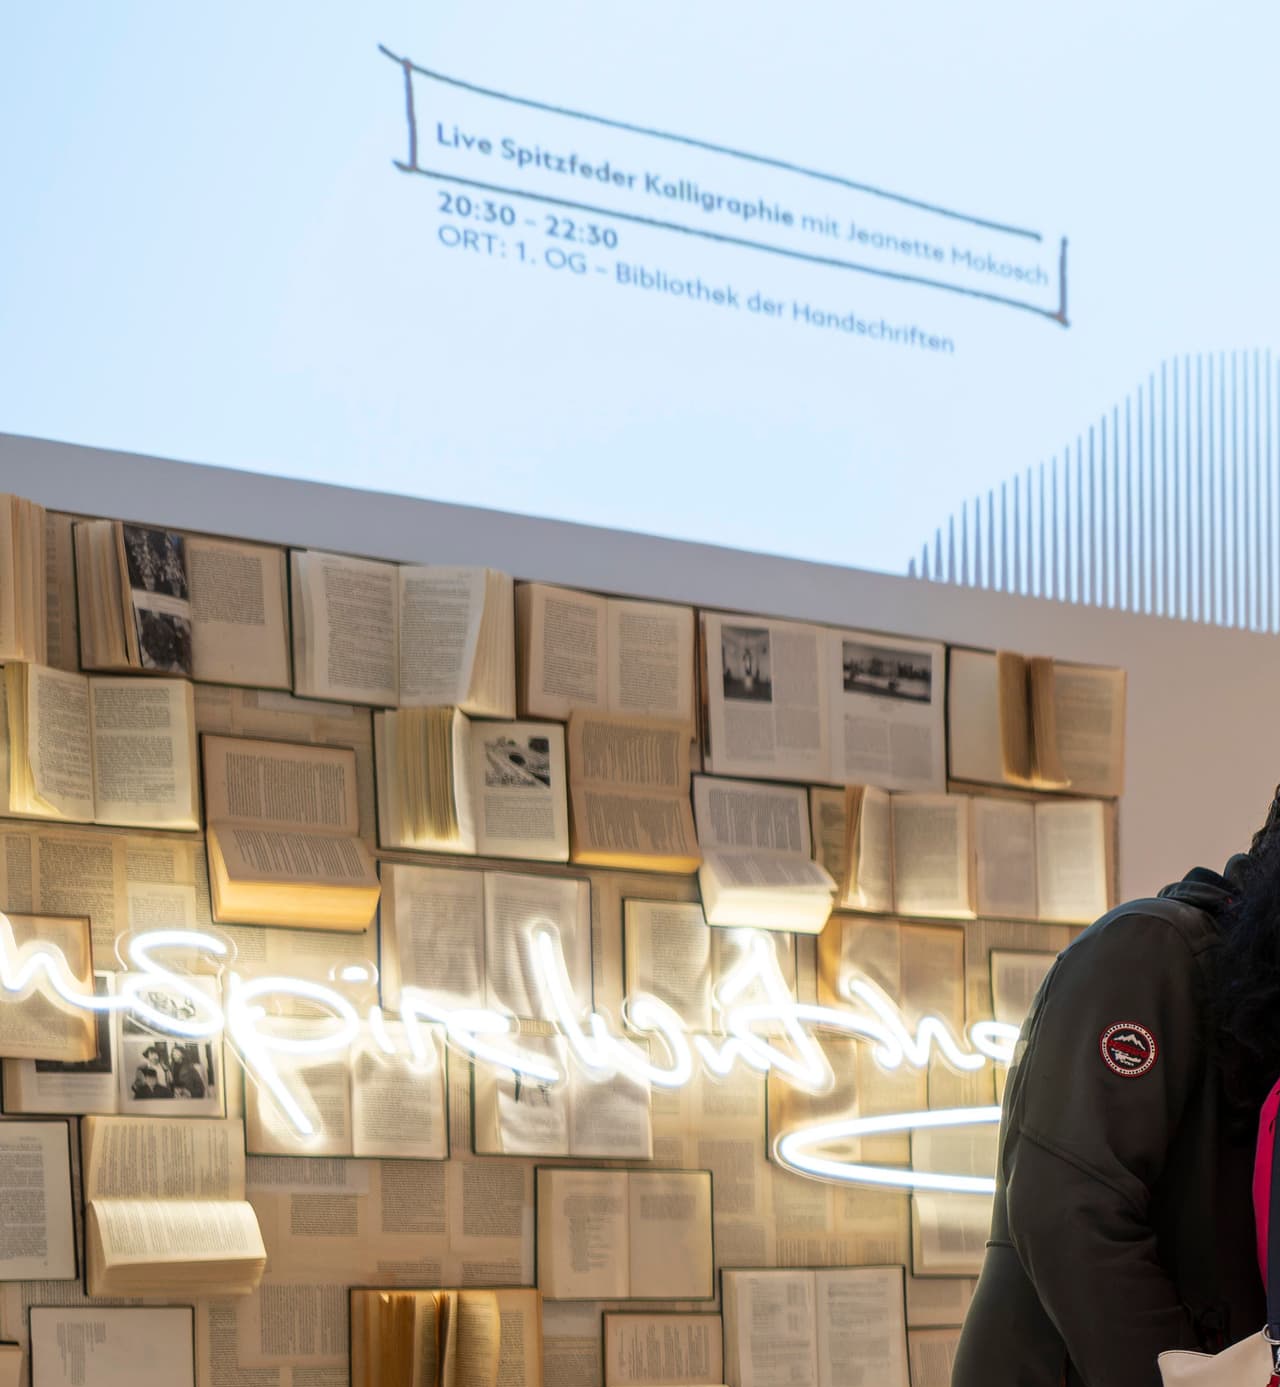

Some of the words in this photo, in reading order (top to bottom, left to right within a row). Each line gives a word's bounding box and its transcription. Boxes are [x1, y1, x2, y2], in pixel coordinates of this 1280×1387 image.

[436, 121, 493, 155] Live
[499, 137, 638, 189] Spitzfeder
[645, 171, 795, 227] Kalligraphie
[800, 210, 839, 240] mit
[846, 220, 945, 262] Jeanette
[950, 246, 1050, 288] Mokosch
[436, 190, 517, 228] 20:30
[545, 214, 619, 250] 22:30
[437, 223, 507, 258] ORT:
[515, 241, 537, 264] 1.
[544, 247, 588, 275] OG
[615, 261, 741, 309] Bibliothek
[747, 290, 786, 318] der
[792, 299, 956, 353] Handschriften
